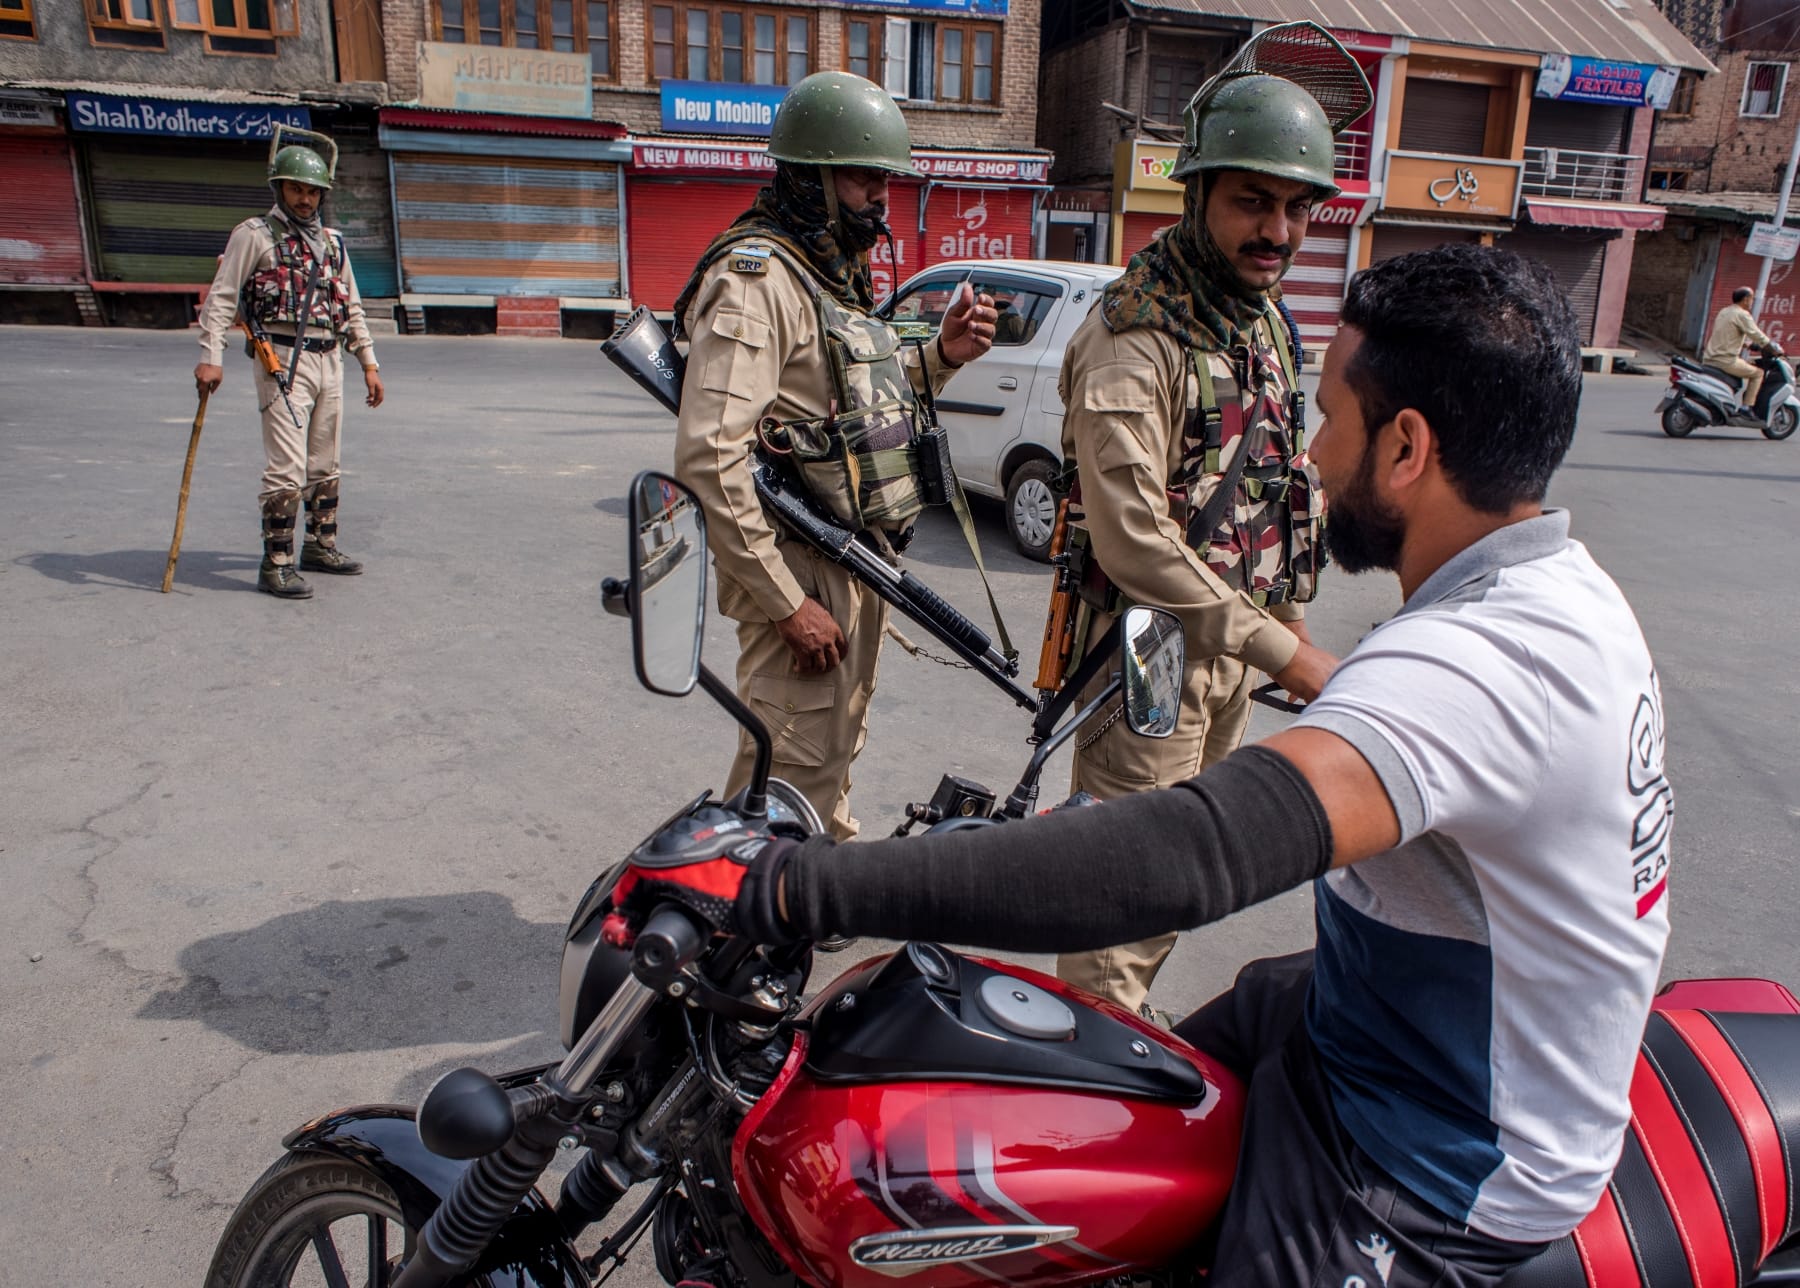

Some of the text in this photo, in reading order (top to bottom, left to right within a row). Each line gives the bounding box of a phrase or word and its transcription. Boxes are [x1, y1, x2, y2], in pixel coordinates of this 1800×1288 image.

[1574, 77, 1643, 97] TEXTILES
[76, 100, 140, 129] Shah
[674, 97, 711, 121] New
[716, 100, 771, 125] Mobile
[643, 148, 679, 164] NEW
[684, 150, 743, 166] MOBILE
[934, 160, 974, 173] MEAT
[976, 162, 1016, 175] SHOP
[940, 229, 1014, 260] airtel
[736, 259, 762, 271] CRP
[862, 1236, 1007, 1260] AVENGER
